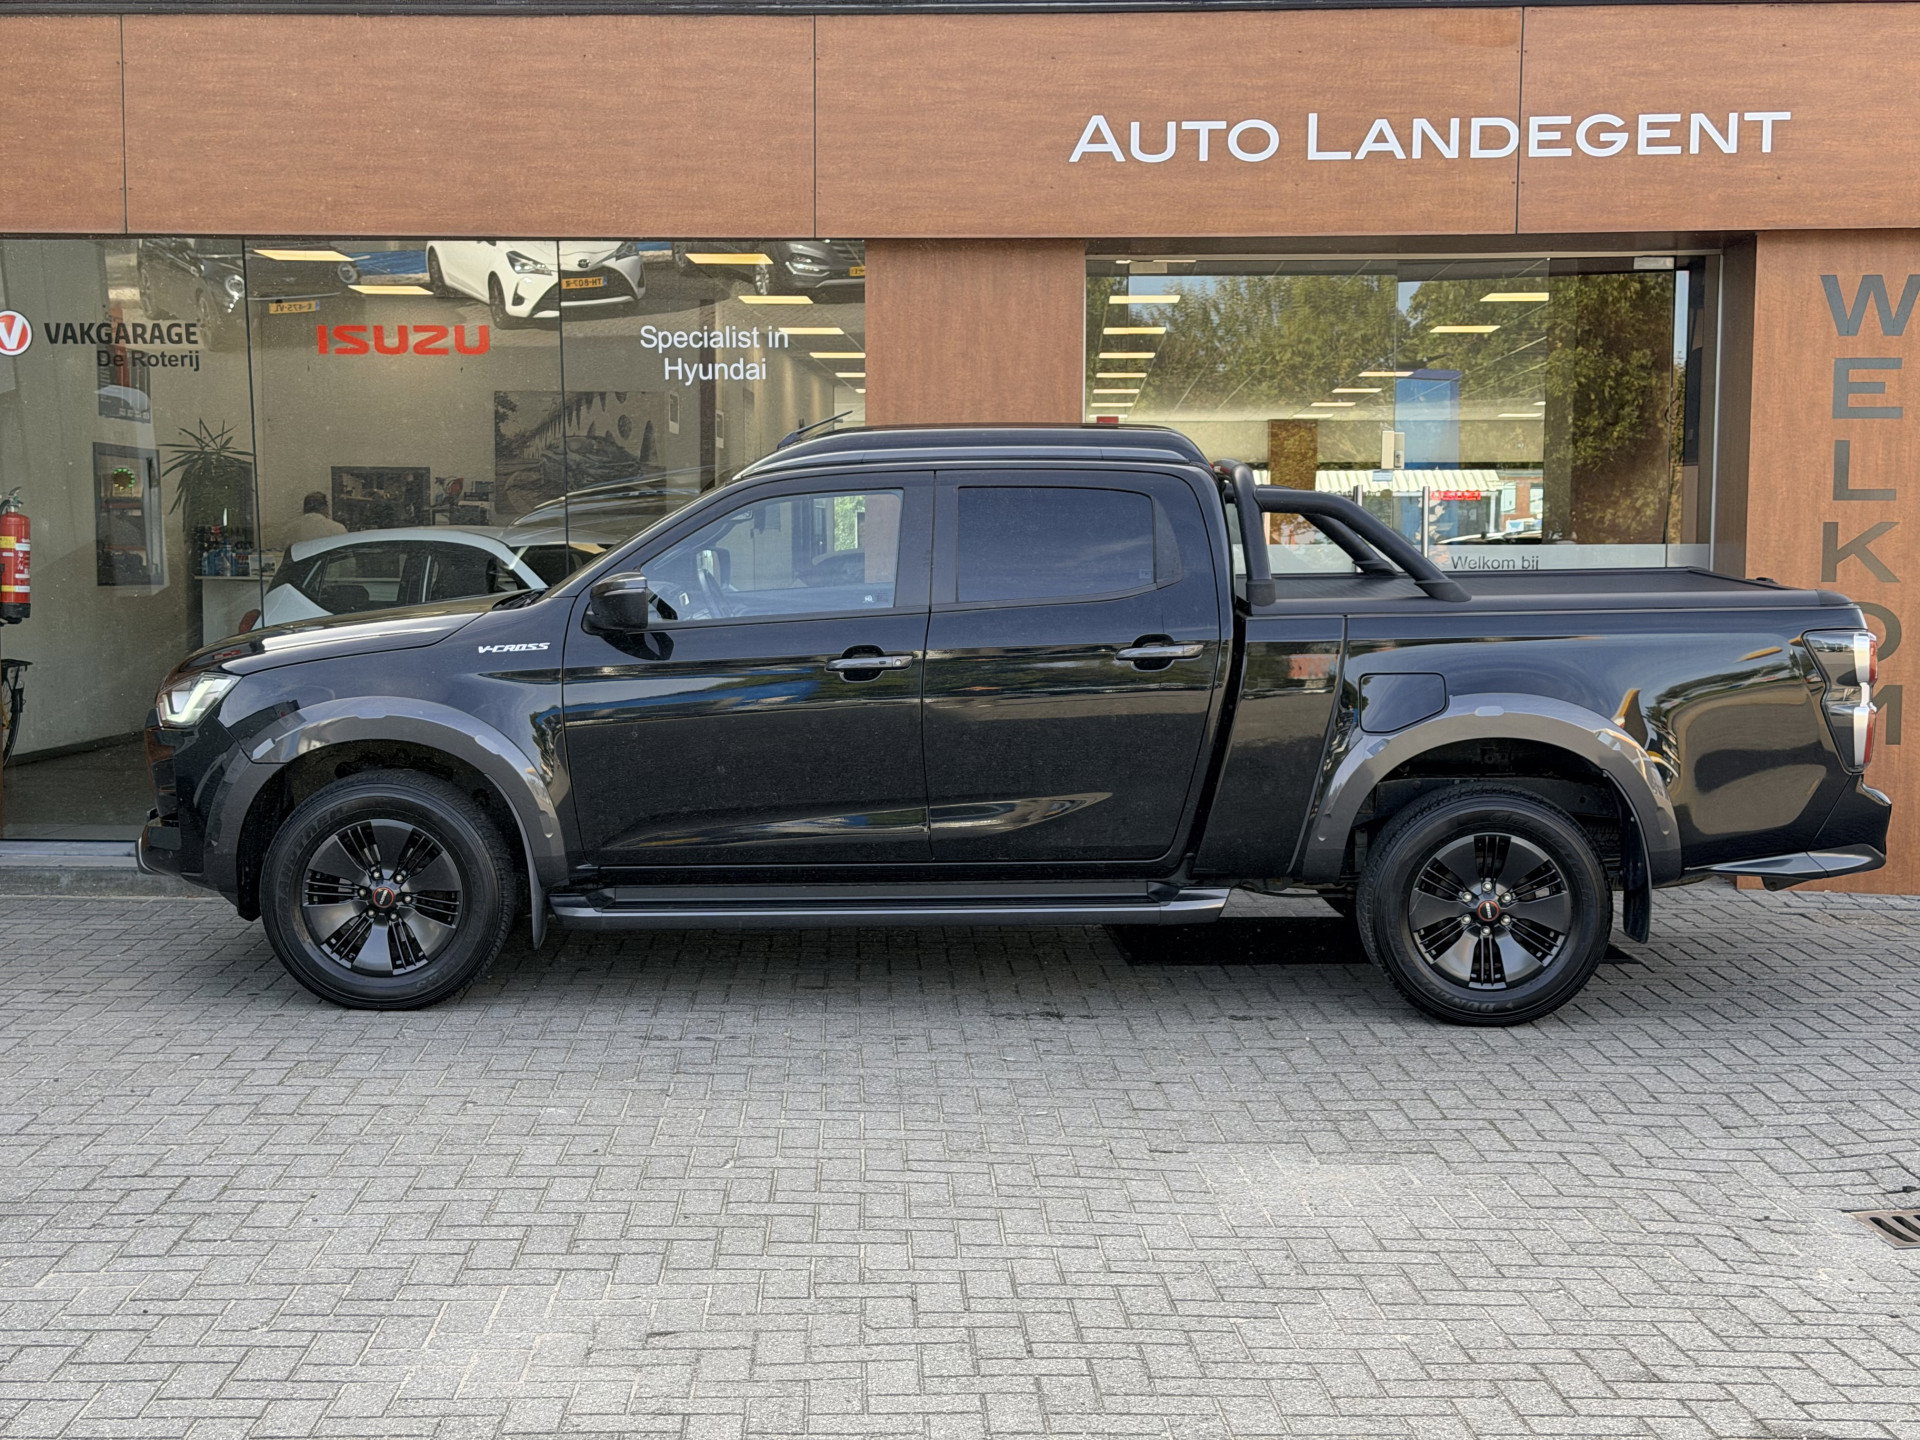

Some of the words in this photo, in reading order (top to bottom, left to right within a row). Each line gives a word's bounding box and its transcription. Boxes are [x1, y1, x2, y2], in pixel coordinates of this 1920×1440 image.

[44, 322, 199, 344] VAKGARAGE
[316, 325, 491, 355] ISUZU
[640, 325, 760, 353] Specialist
[768, 326, 789, 348] in
[97, 351, 124, 367] De
[132, 351, 200, 371] Roterij
[664, 358, 767, 386] Hyundai
[1451, 556, 1516, 569] Welkom
[1521, 555, 1540, 570] bij
[478, 642, 551, 653] V-CROSS
